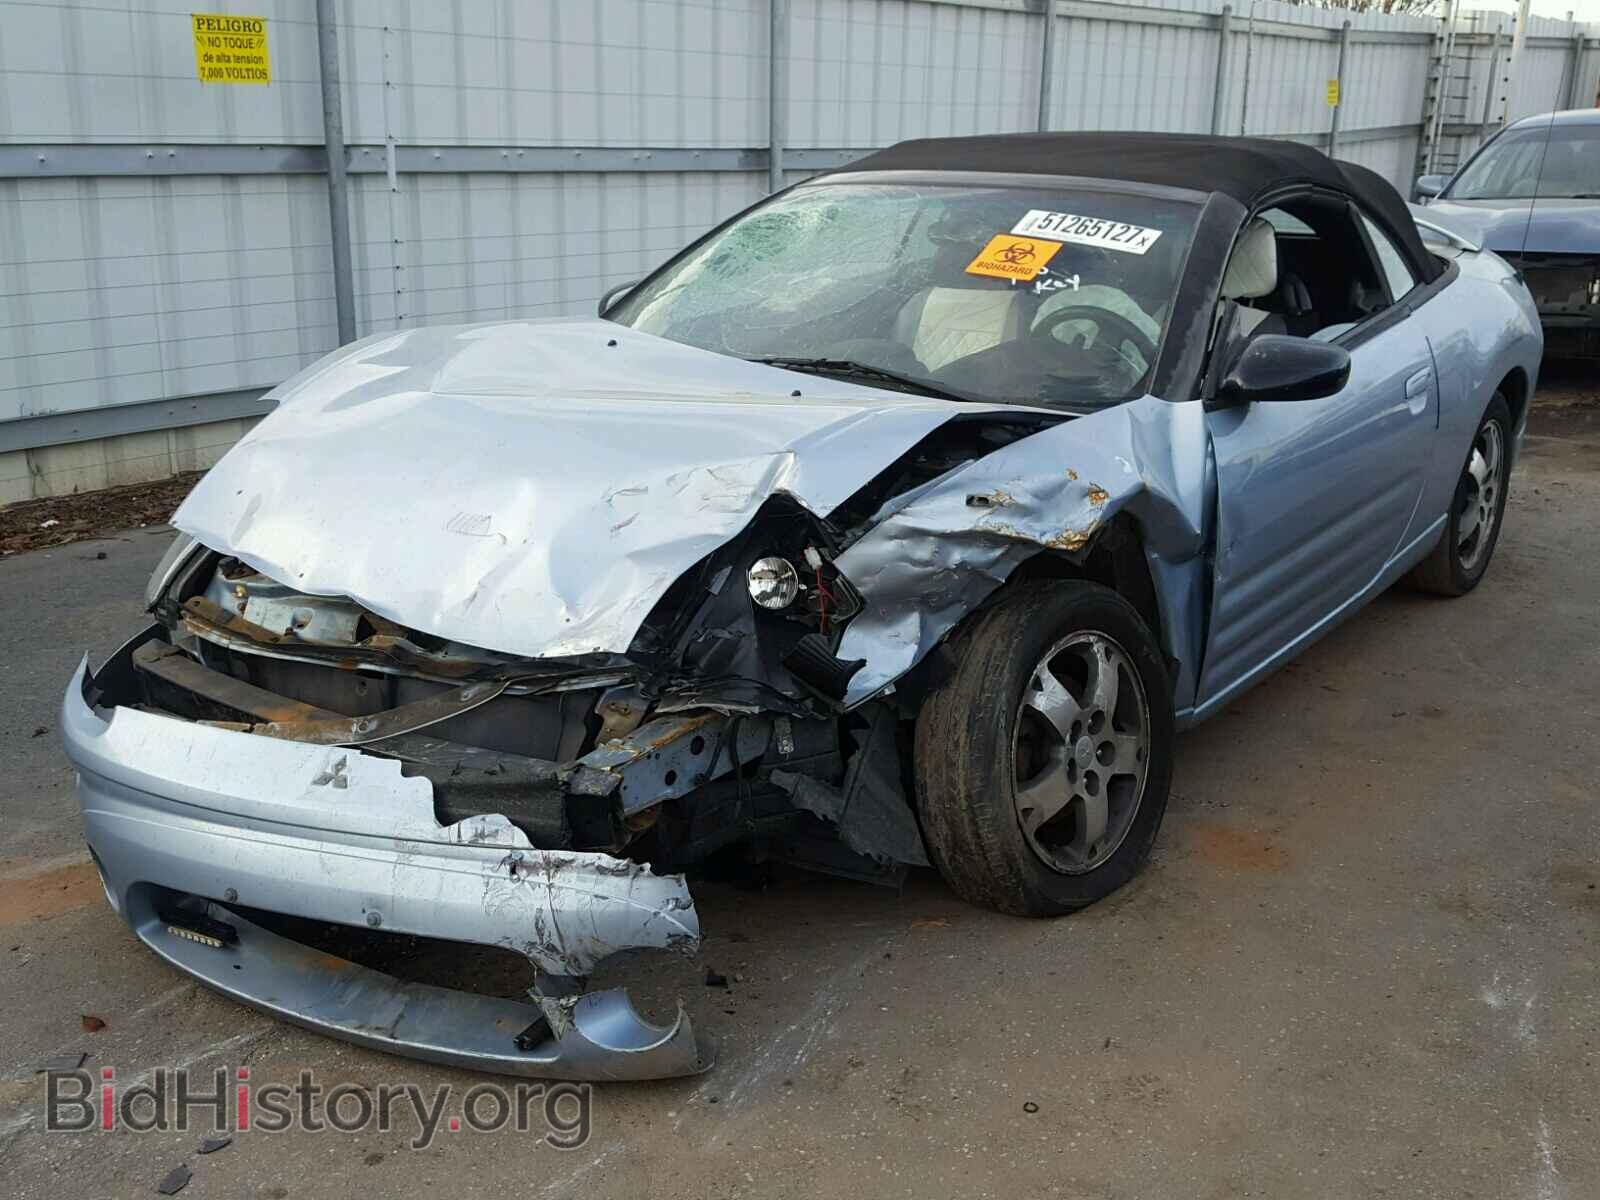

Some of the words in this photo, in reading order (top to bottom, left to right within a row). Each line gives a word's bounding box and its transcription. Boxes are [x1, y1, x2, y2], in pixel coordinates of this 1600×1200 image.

[196, 17, 263, 33] PELIGRO
[207, 36, 221, 48] NO
[223, 37, 254, 49] TOQUE
[203, 52, 214, 63] de
[216, 52, 231, 64] alta
[233, 54, 264, 65] tension
[200, 67, 224, 80] 7,000
[225, 67, 268, 80] VOLTIOS
[976, 261, 1033, 276] BIOHAZARD
